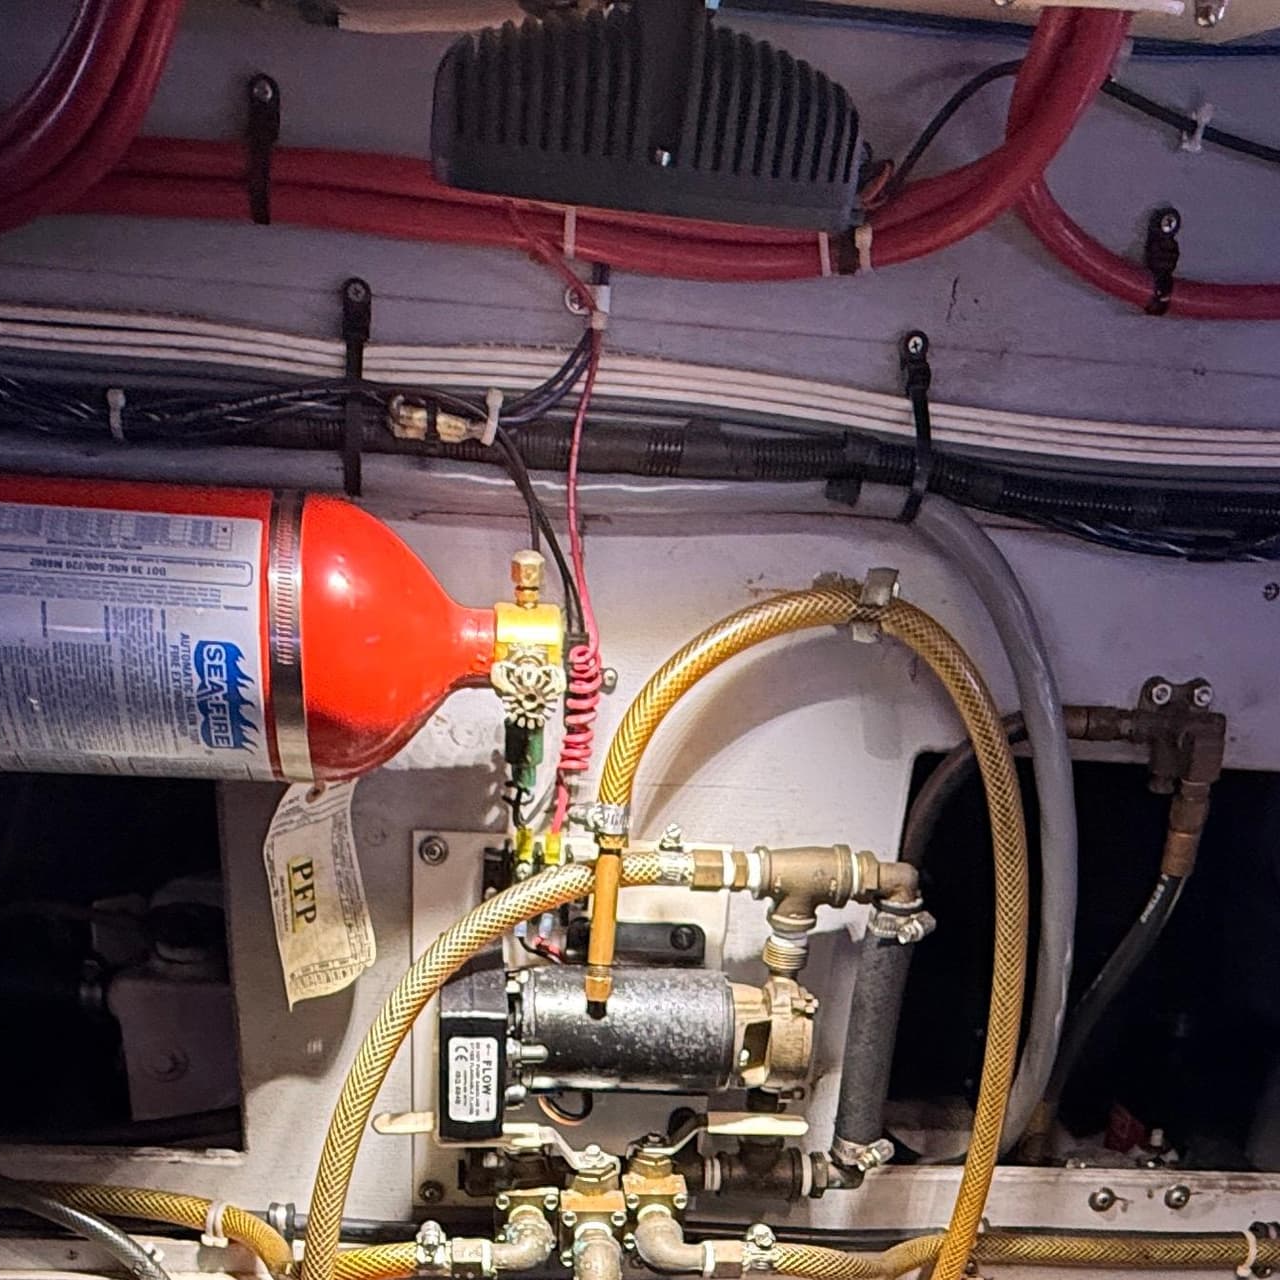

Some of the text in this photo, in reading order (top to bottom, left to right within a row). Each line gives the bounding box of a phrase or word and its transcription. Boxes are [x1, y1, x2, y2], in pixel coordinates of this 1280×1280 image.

[169, 644, 181, 667] FIRE
[180, 632, 194, 694] AUTOMATIC
[291, 857, 318, 926] PFP
[482, 1060, 493, 1095] FLOW
